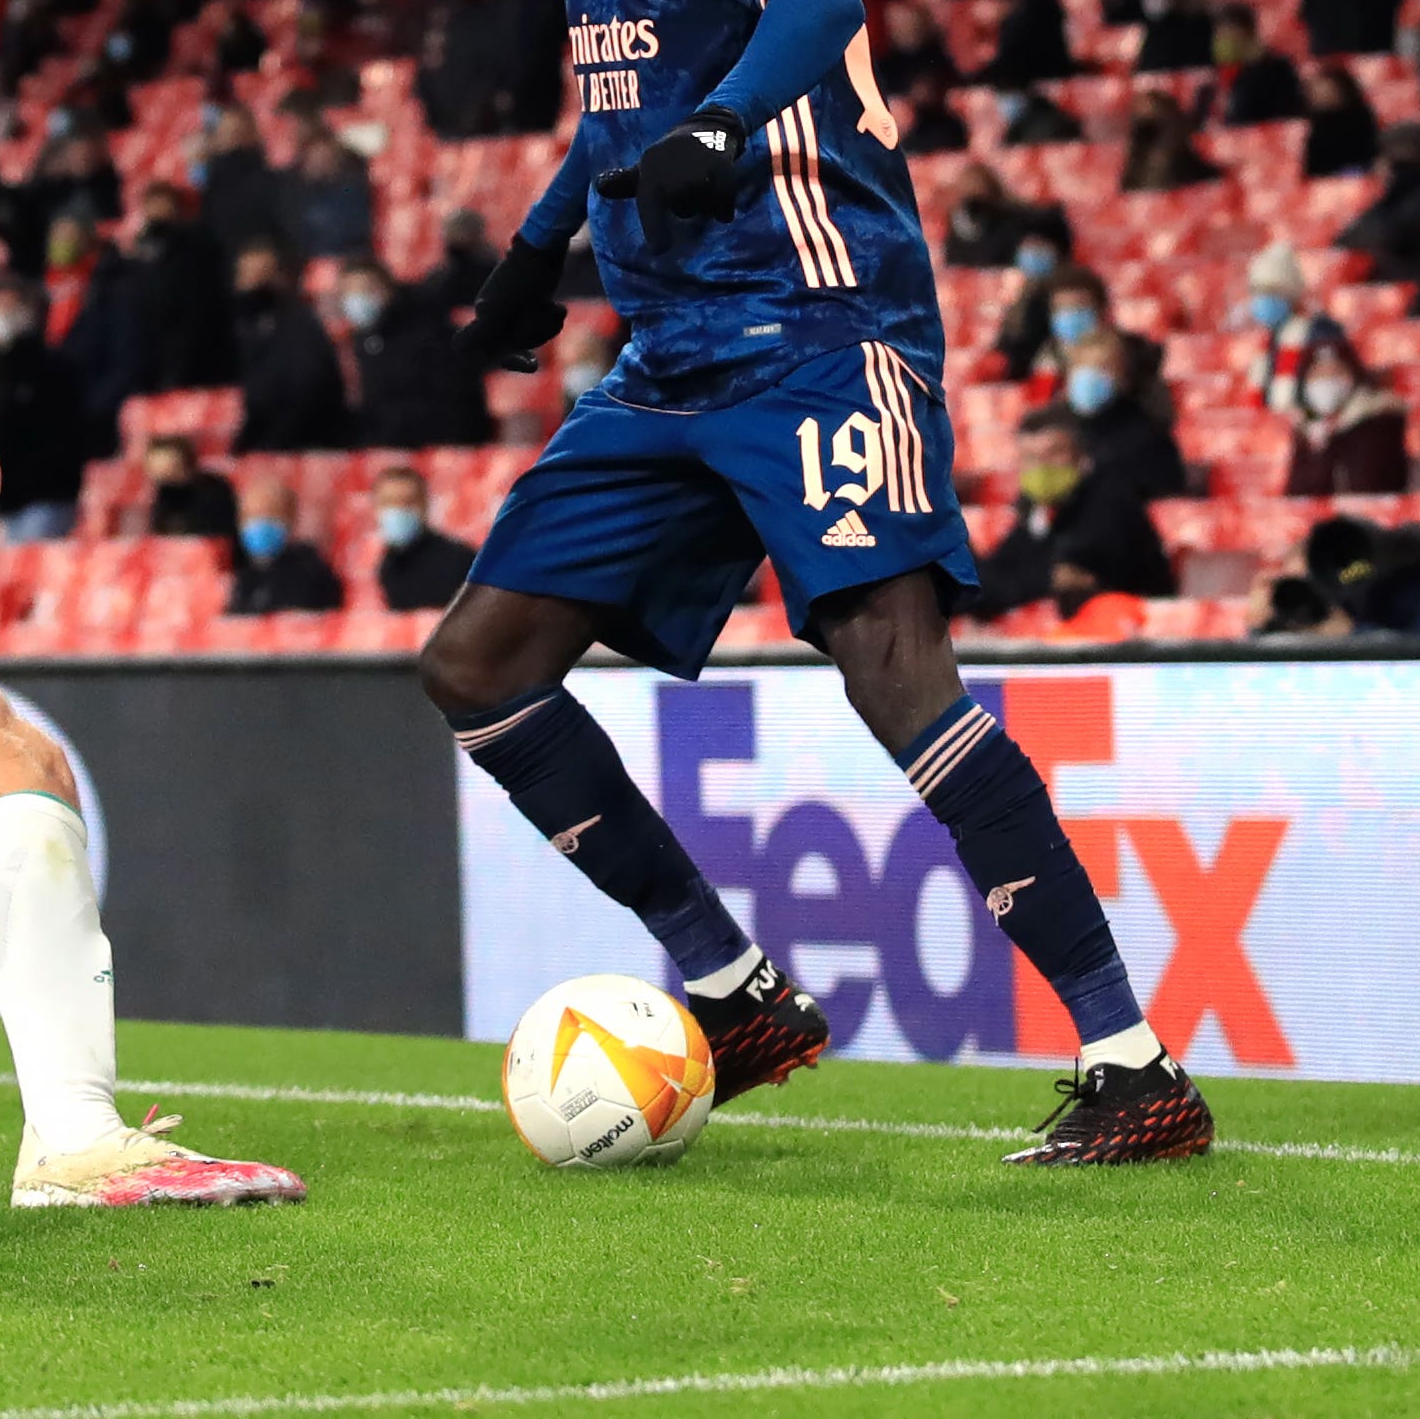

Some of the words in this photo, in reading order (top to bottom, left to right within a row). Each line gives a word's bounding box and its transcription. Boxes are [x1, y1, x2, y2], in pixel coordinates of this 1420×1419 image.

[568, 14, 660, 65] mirates
[588, 70, 641, 112] BETTER
[796, 411, 883, 511] 19
[821, 532, 876, 547] adidas
[656, 676, 1299, 1067] FedEx
[581, 1116, 635, 1159] molten
